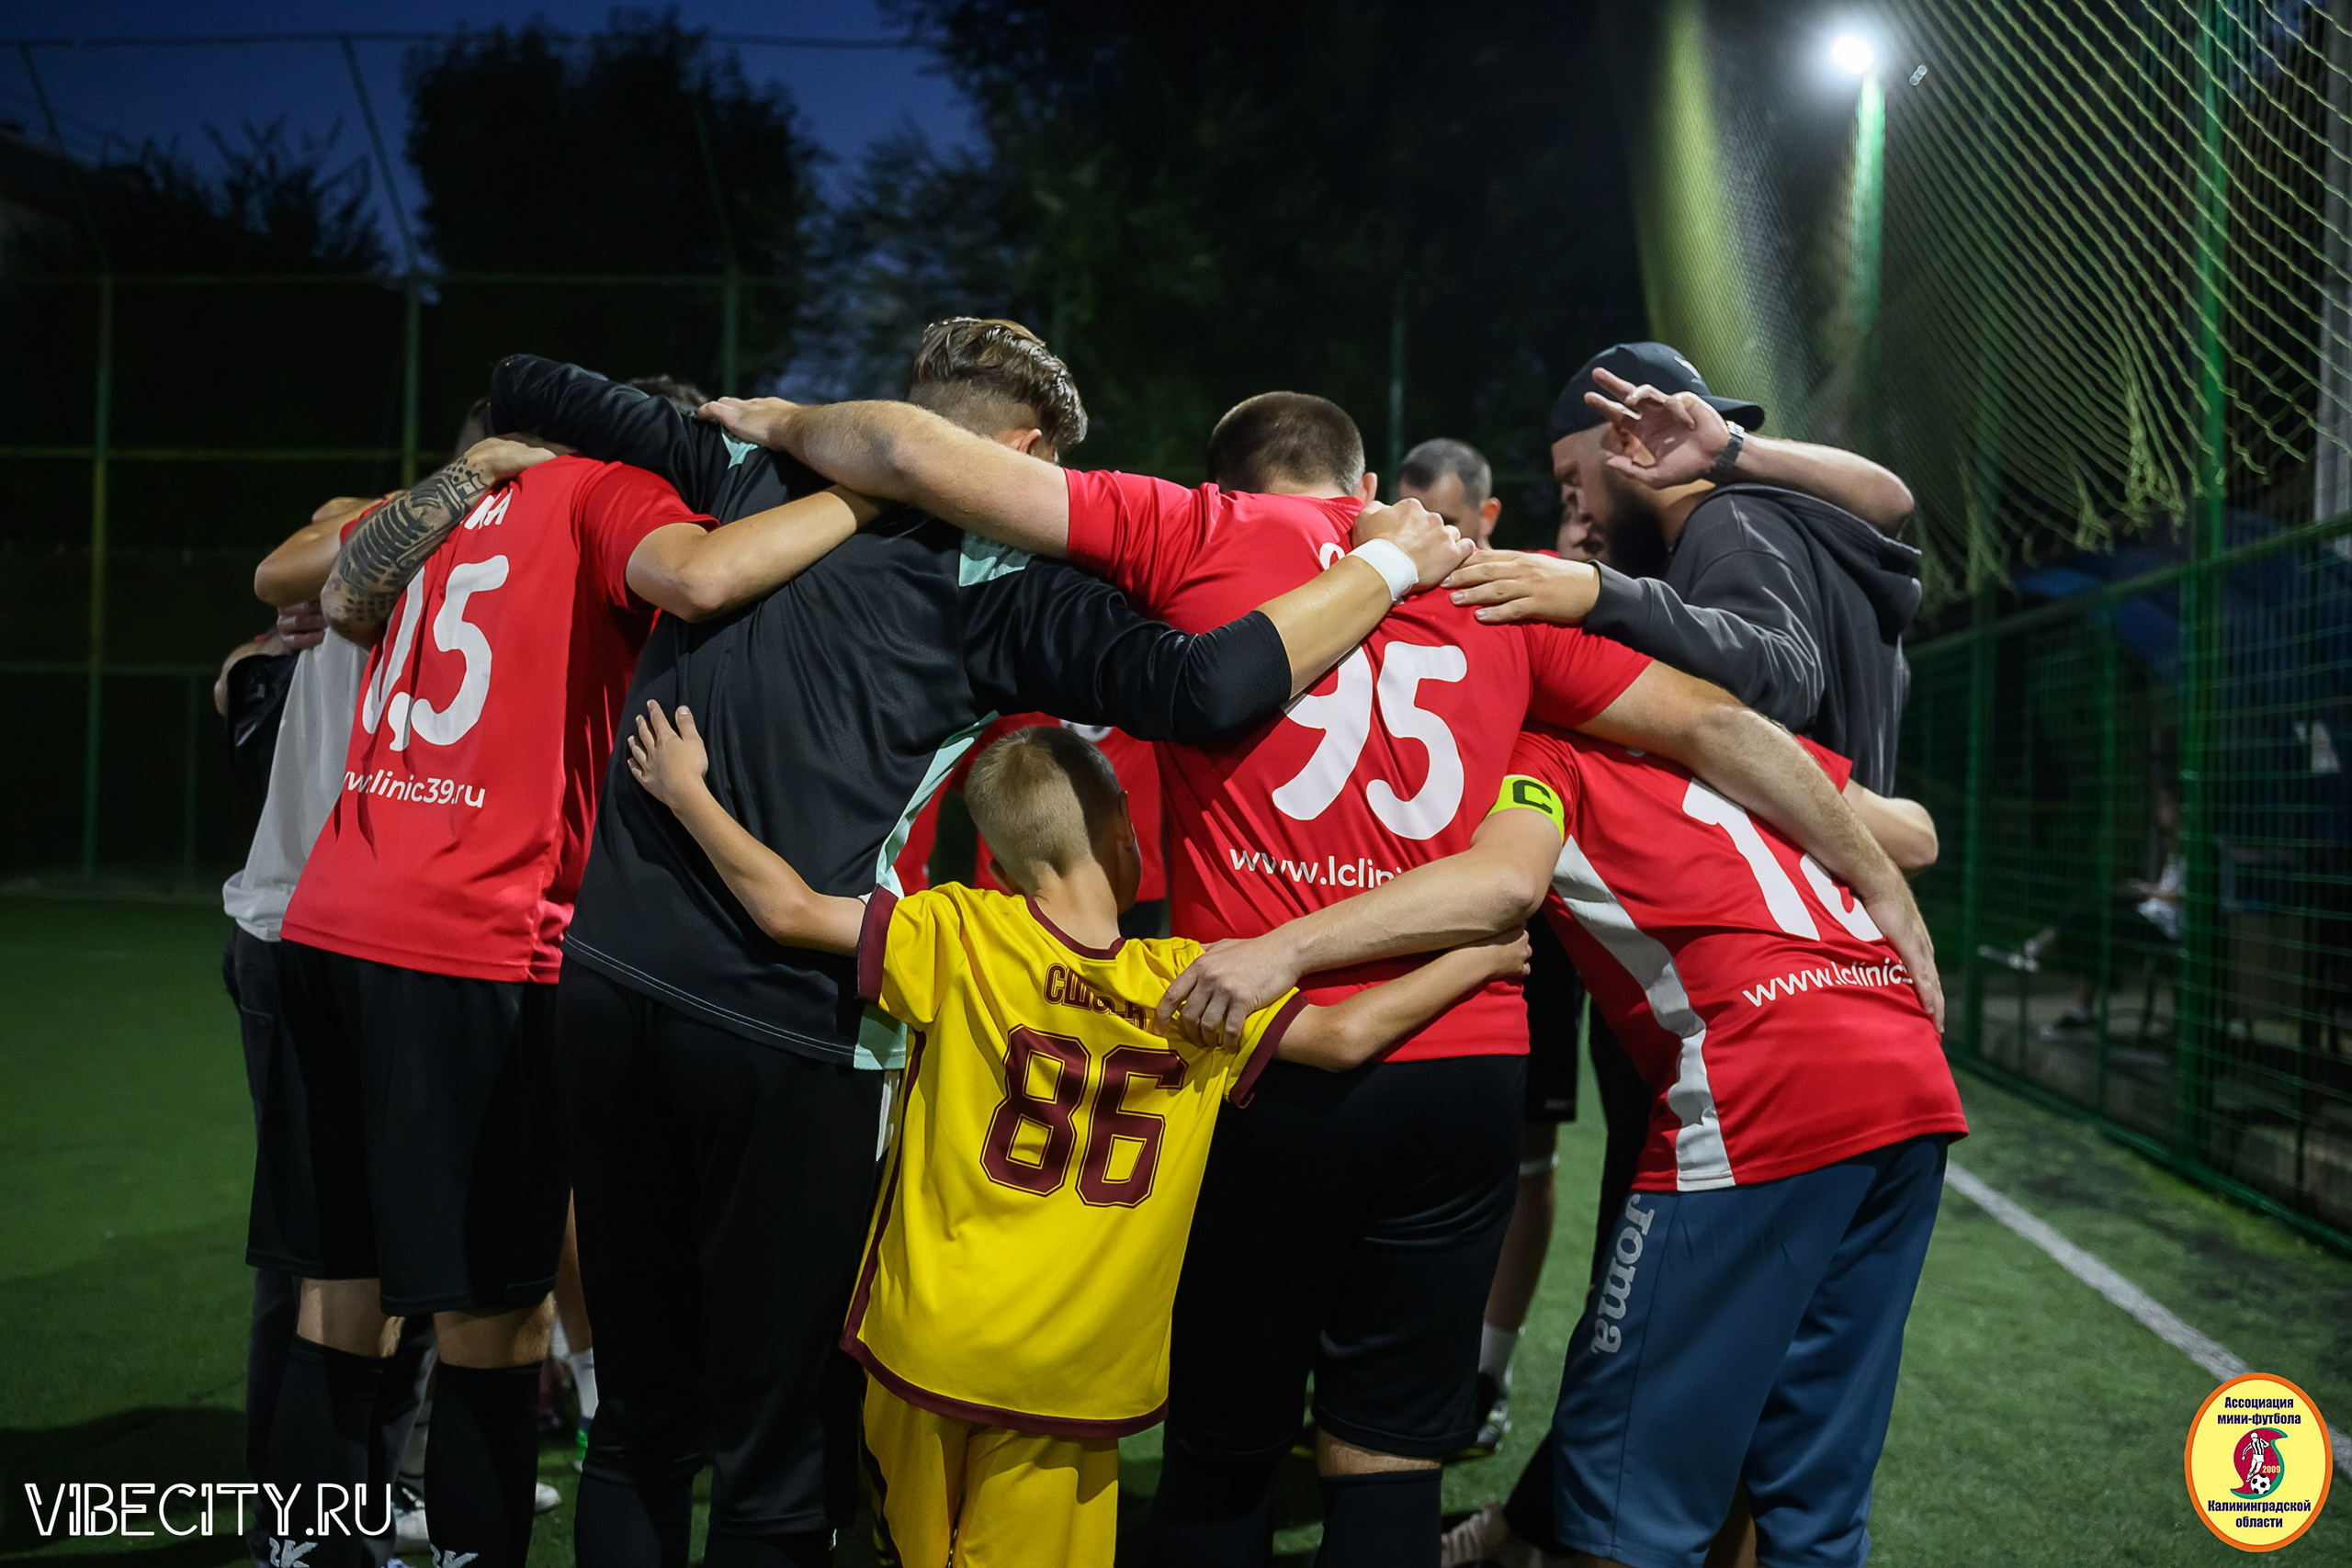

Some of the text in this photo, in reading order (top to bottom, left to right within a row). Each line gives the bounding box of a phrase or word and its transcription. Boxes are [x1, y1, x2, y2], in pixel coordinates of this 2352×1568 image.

[1272, 641, 1467, 840] 95
[1512, 779, 1554, 815] C
[1229, 848, 1402, 889] www.lclin
[979, 1023, 1189, 1209] 86
[1590, 1194, 1656, 1354] Joma
